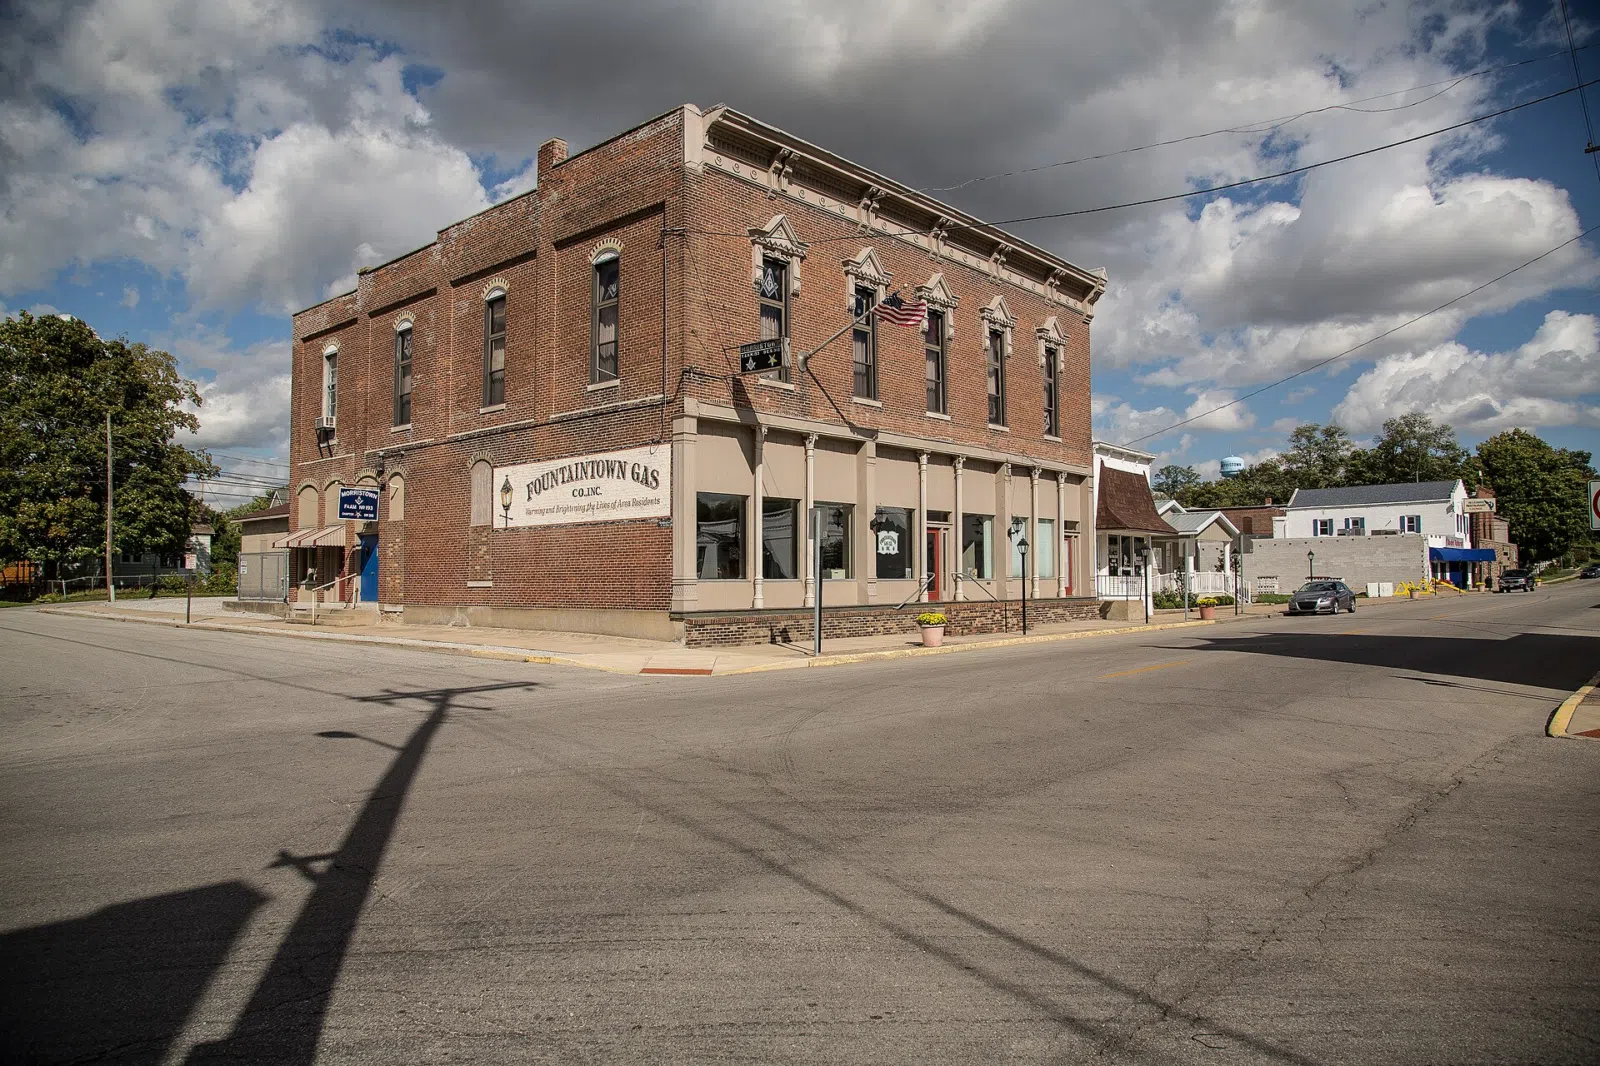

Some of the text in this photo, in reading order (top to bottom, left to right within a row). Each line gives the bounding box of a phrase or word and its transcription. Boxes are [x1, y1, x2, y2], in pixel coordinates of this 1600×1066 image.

[526, 460, 660, 502] FOUNTAINTOWN GAS
[341, 490, 378, 499] MORRISTOWN
[546, 506, 555, 514] and
[596, 500, 610, 510] Lives
[611, 500, 617, 510] of
[617, 499, 631, 508] Area
[632, 496, 661, 507] Residents
